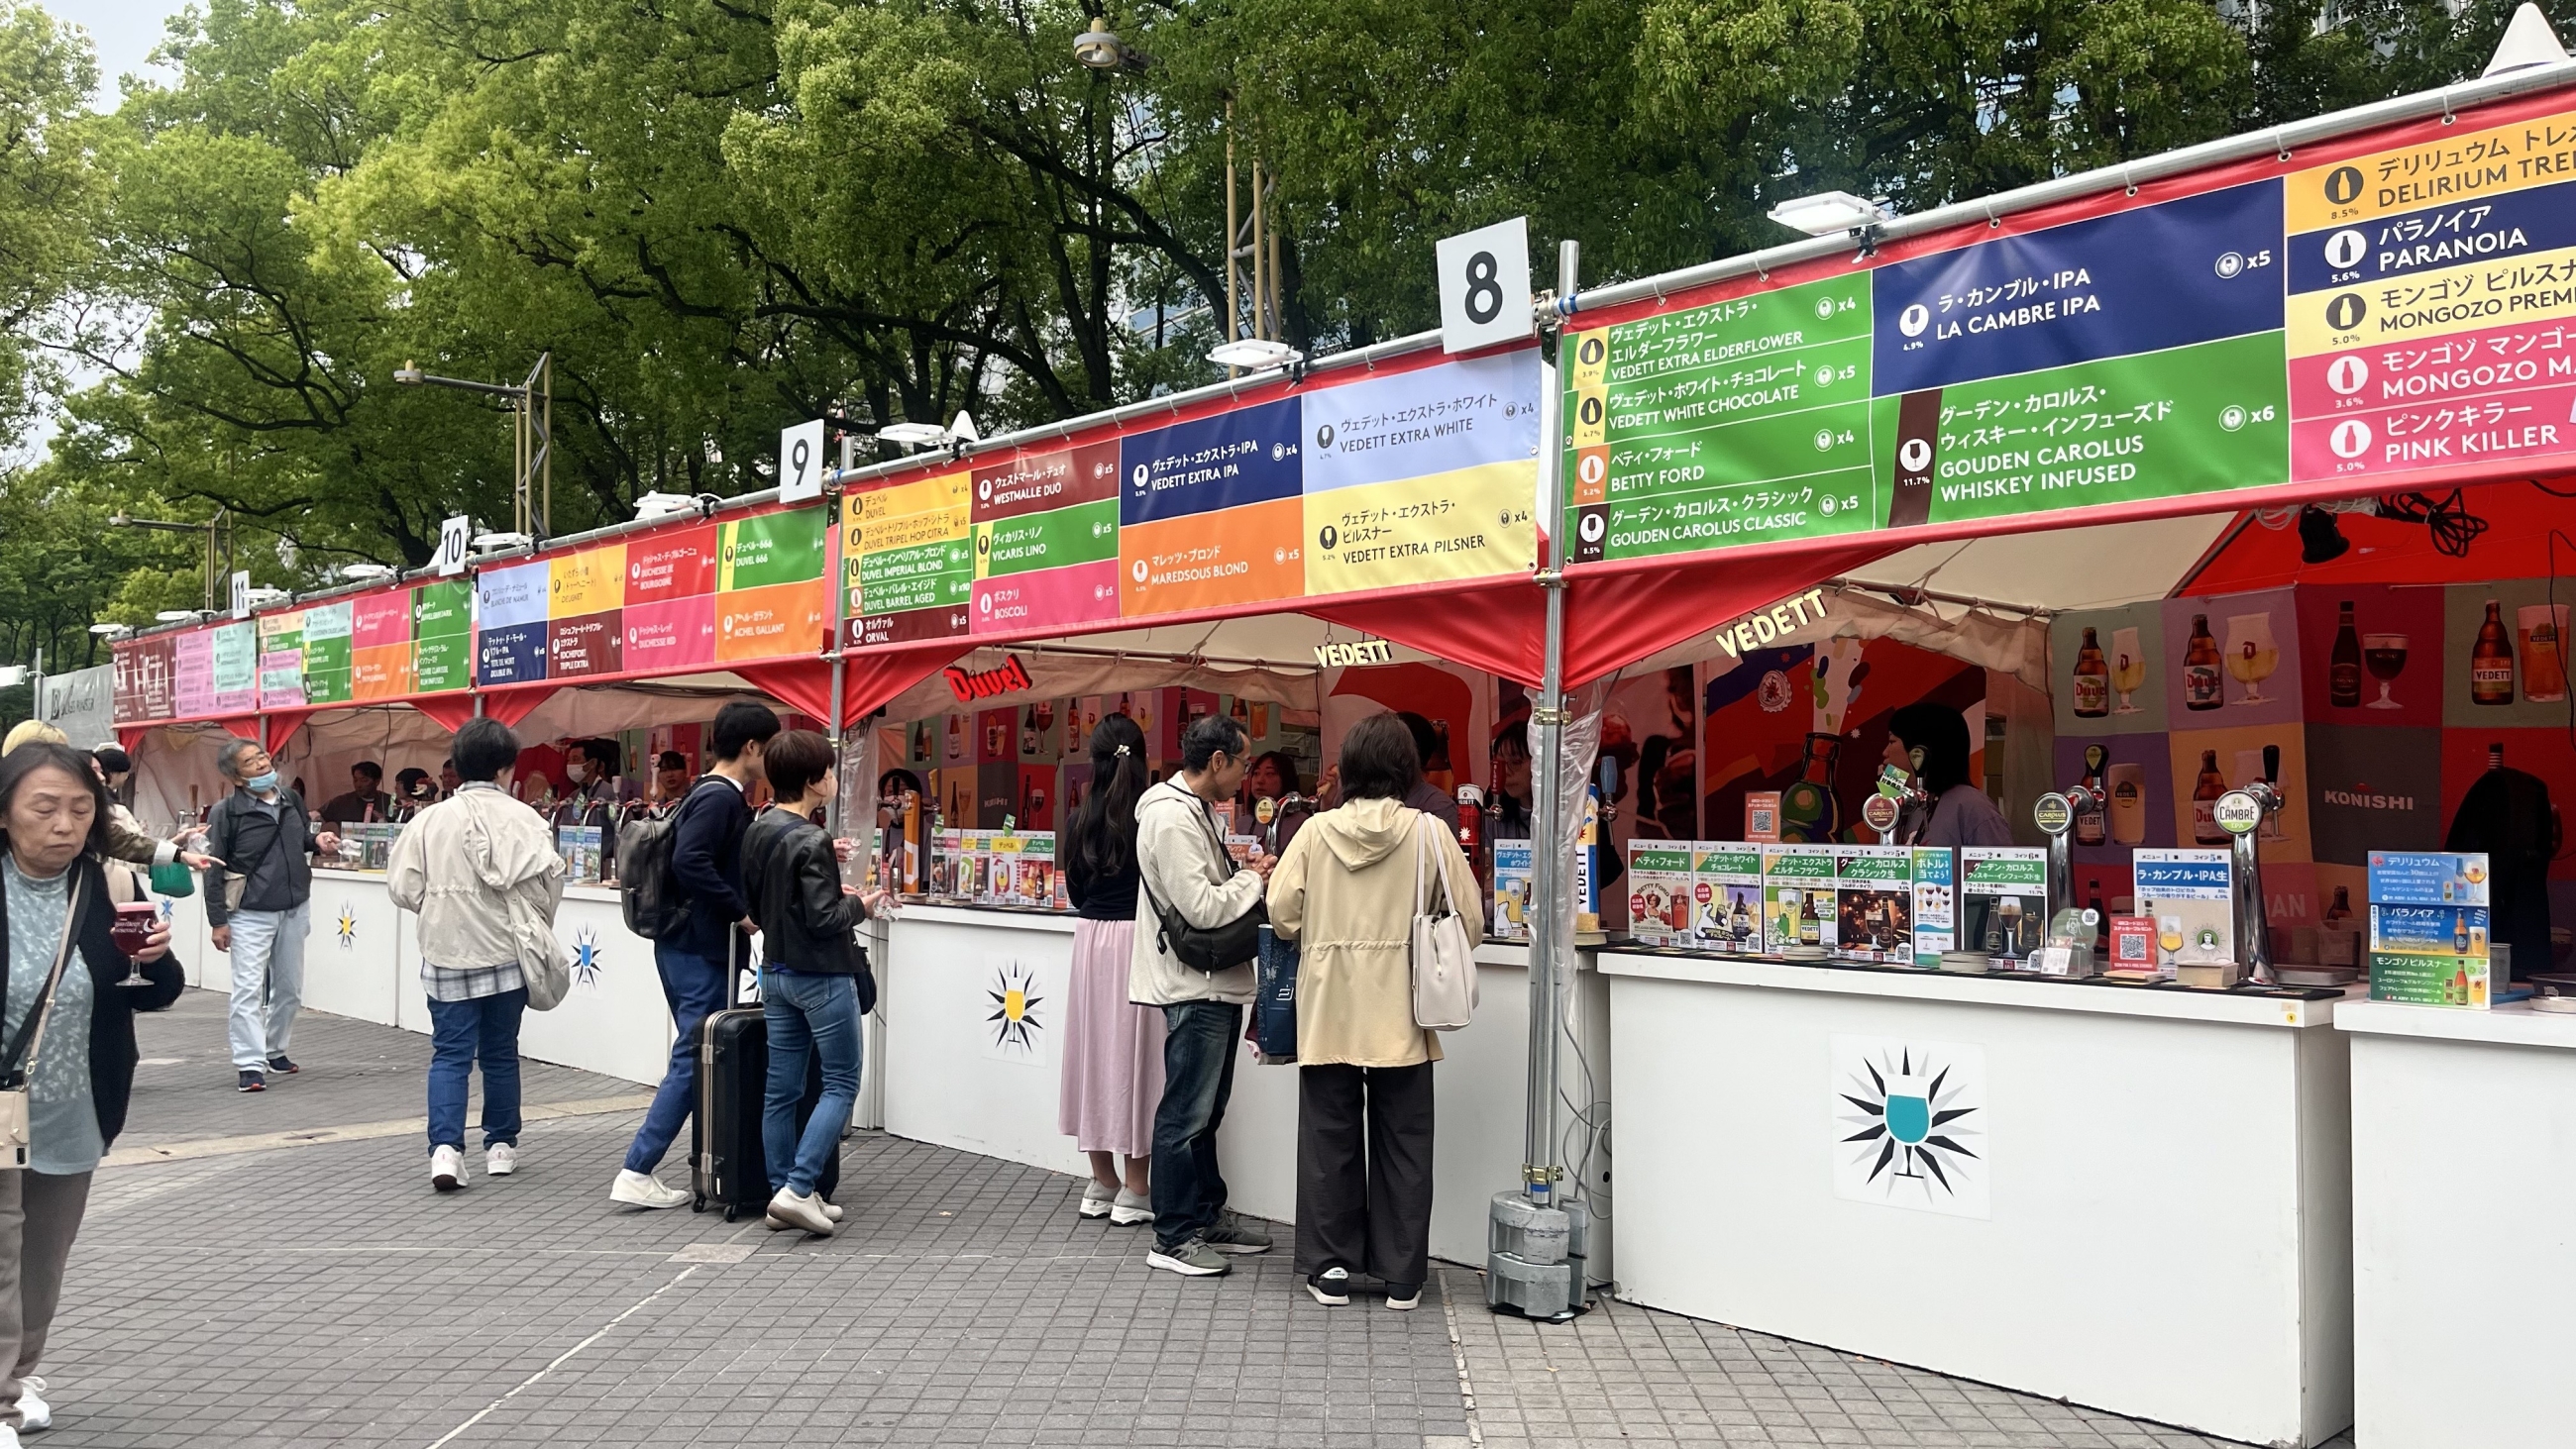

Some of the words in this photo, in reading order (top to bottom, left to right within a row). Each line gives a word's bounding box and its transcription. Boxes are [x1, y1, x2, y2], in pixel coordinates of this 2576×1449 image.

[2378, 139, 2510, 181] デリリュウム
[2379, 164, 2508, 207] DELIRIUM
[2519, 152, 2576, 179] TRE
[2331, 208, 2359, 220] 8.5%
[2380, 205, 2492, 246] パラノイア
[2247, 251, 2270, 269] x5
[2380, 228, 2527, 271] PARANOIA
[1464, 251, 1503, 325] 8
[2331, 271, 2360, 283] 5.6%
[1938, 268, 2091, 313] ラ・カンブル・IPA
[2381, 274, 2474, 309] モンゴゾ
[1839, 299, 1856, 311] x4
[2380, 299, 2502, 332] MONGOZO
[1610, 302, 1758, 344] ヴェデット・エクストラ・
[1937, 323, 1962, 341] LA
[1968, 306, 2056, 334] CAMBRE
[2062, 295, 2100, 316] IPA
[1611, 332, 1718, 364] エルダーフラワー
[2332, 335, 2360, 345] 5.0%
[1611, 361, 1656, 380] VEDETT
[1658, 353, 1700, 371] EXTRA
[1704, 331, 1803, 362] ELDERFLOWER
[2382, 339, 2476, 372] モンゴゾ
[1610, 360, 1807, 408] ヴェデット・ホワイト・チョコレート
[1838, 365, 1855, 379] x5
[2383, 360, 2536, 399] MONGOZO
[2548, 356, 2576, 376] M
[1341, 393, 1497, 433] ヴェデット・エクストラ・ホワイト
[1521, 403, 1534, 414] x4
[1609, 410, 1660, 430] VEDETT
[1664, 400, 1706, 419] WHITE
[1708, 385, 1799, 412] CHOCOLATE
[1940, 386, 2106, 426] グーデン・カロルス・
[2251, 406, 2275, 424] x6
[1941, 399, 2174, 451] ウィスキー・インフューズド
[2387, 404, 2532, 437] ピンクキラー
[1340, 435, 1386, 454] VEDETT
[1391, 426, 1431, 446] EXTRA
[1434, 418, 1473, 439] WHITE
[1837, 430, 1854, 444] x4
[2386, 437, 2450, 464] PINK
[2462, 425, 2559, 454] KILLER
[1152, 440, 1258, 473] ヴェデット・エクストラ・IPA
[1286, 444, 1297, 455] x4
[1611, 441, 1703, 466] ベティ・フォード
[1941, 452, 2029, 478] GOUDEN
[2037, 436, 2144, 465] CAROLUS
[792, 439, 808, 486] 9
[995, 465, 1066, 488] ウェストマール・デュオ
[1151, 473, 1186, 491] VEDETT
[1188, 467, 1221, 484] EXTRA
[1224, 464, 1239, 477] IPA
[1611, 470, 1655, 491] BETTY
[1659, 466, 1705, 484] FORD
[1941, 474, 2033, 502] WHISKEY
[2041, 463, 2136, 489] INFUSED
[866, 494, 888, 506] デュベル
[994, 487, 1041, 505] WESTMALLE
[1043, 482, 1061, 495] DUO
[1841, 496, 1859, 509] x5
[866, 507, 886, 519] DUVEL
[1342, 501, 1455, 527] ヴェデット・エクストラ・
[1515, 511, 1528, 522] x4
[1611, 485, 1813, 527] グーデン・カロルス・クラシック
[864, 539, 884, 550] DUVEL
[886, 535, 908, 546] TRIPEL
[911, 532, 926, 541] HOP
[927, 527, 949, 538] CITRA
[993, 526, 1042, 546] ヴィカリス・リノ
[1343, 526, 1392, 544] ピルスナー
[1610, 527, 1669, 548] GOUDEN
[1672, 519, 1741, 540] CAROLUS
[1744, 512, 1806, 530] CLASSIC
[445, 528, 462, 565] 10
[993, 548, 1023, 561] VICARIS
[1026, 544, 1046, 556] LINO
[1152, 545, 1221, 567] マレッツ・ブロンド
[1343, 547, 1386, 565] VEDETT
[1390, 541, 1430, 557] EXTRA
[1434, 535, 1485, 554] PILSNER
[736, 557, 754, 567] DUVEL
[756, 554, 768, 564] 666
[862, 569, 883, 579] DUVEL
[884, 564, 915, 576] IMPERIAL
[917, 560, 942, 572] BLOND
[1151, 567, 1211, 585] MAREDSOUS
[1214, 562, 1248, 577] BLOND
[235, 580, 245, 610] 11
[864, 600, 884, 611] DUVEL
[886, 596, 912, 607] BARREL
[914, 592, 935, 603] AGED
[994, 605, 1027, 619] BOSCOLI
[1715, 588, 1827, 659] VEDETT
[735, 626, 754, 637] ACHEL
[756, 623, 785, 635] GALLANT
[866, 632, 889, 643] ORVAL
[1314, 640, 1392, 668] VEDETT
[943, 653, 1032, 702] Duvel
[2476, 671, 2510, 679] VEDETT
[2324, 790, 2414, 810] KONISHI
[2080, 817, 2104, 826] VEDET
[2219, 806, 2255, 821] CAMBRE
[1636, 857, 1685, 867] ベティ・フォード
[1841, 858, 1906, 868] グーデン・カロルス
[1851, 869, 1896, 879] クラシック生
[1974, 863, 2034, 872] グーデン・カロルス
[2388, 858, 2439, 867] デリリュウム
[2138, 870, 2227, 881] ラ・カンブル・IPA生
